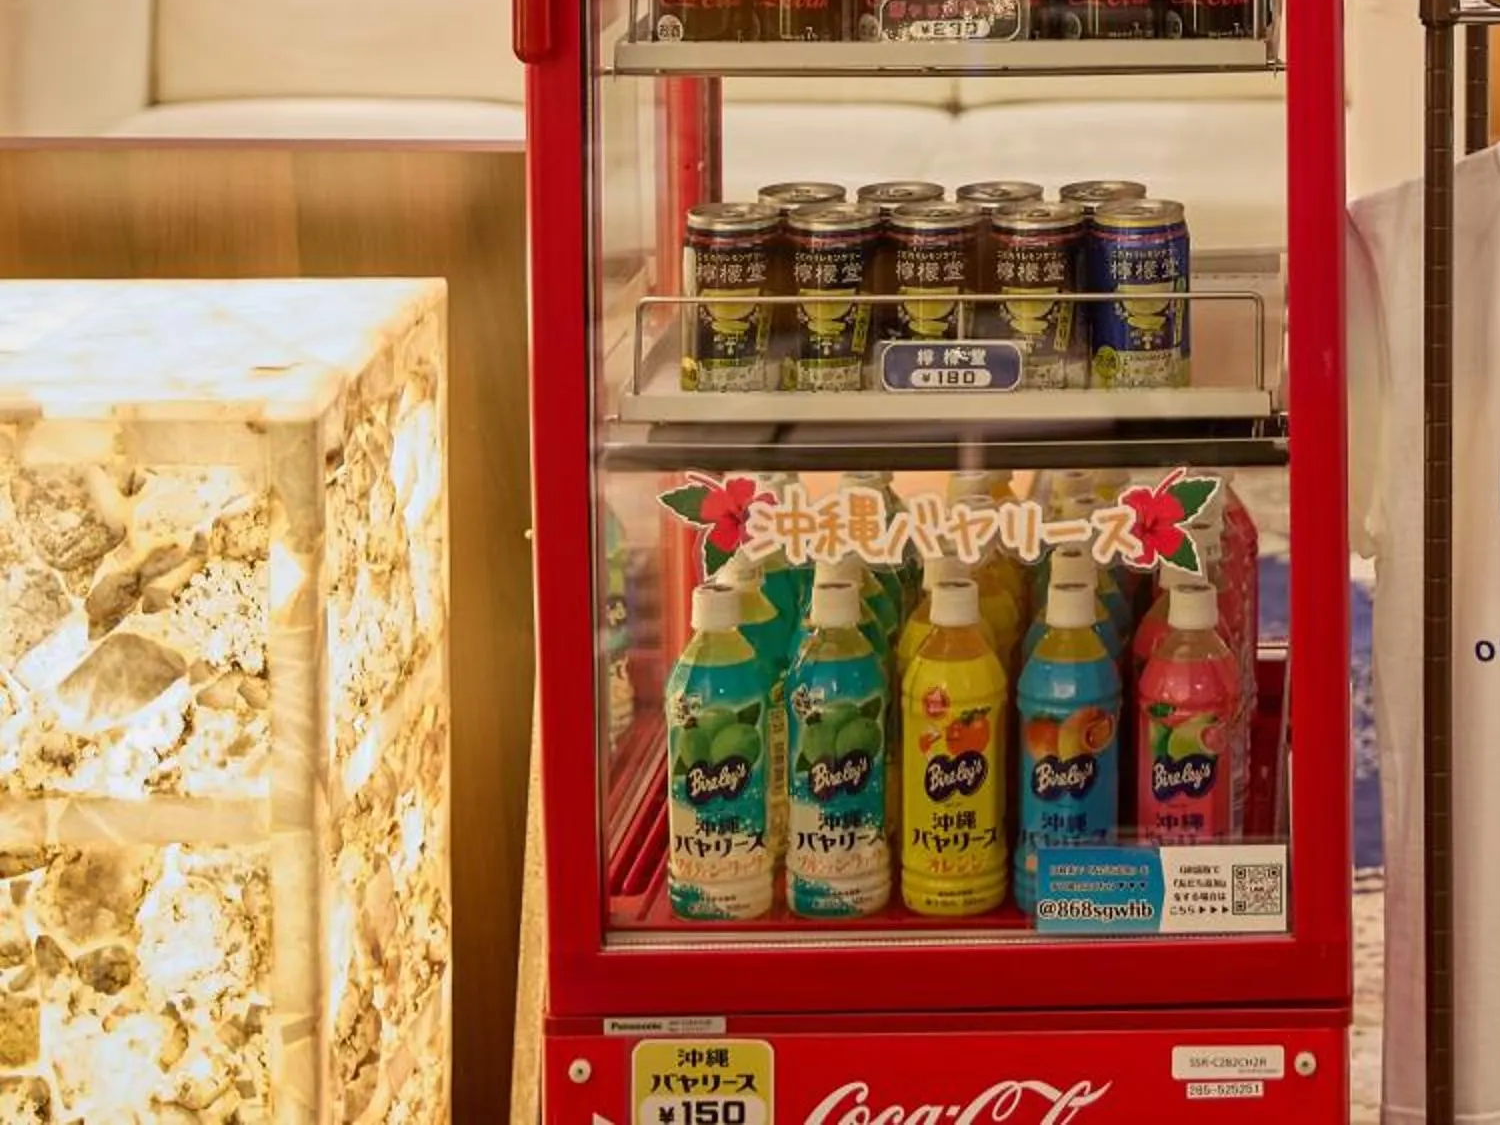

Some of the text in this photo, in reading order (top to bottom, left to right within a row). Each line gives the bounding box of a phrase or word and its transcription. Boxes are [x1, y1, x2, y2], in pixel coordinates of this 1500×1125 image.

[921, 370, 975, 384] ¥180
[750, 491, 1140, 560] 沖縄バヤリース
[932, 811, 977, 831] 沖縄
[675, 833, 767, 857] バヤリース
[797, 828, 885, 853] バヤリース
[912, 827, 998, 853] バヤリース
[677, 1048, 730, 1068] 沖縄
[651, 1074, 758, 1093] バヤリース
[659, 1100, 746, 1125] ¥150
